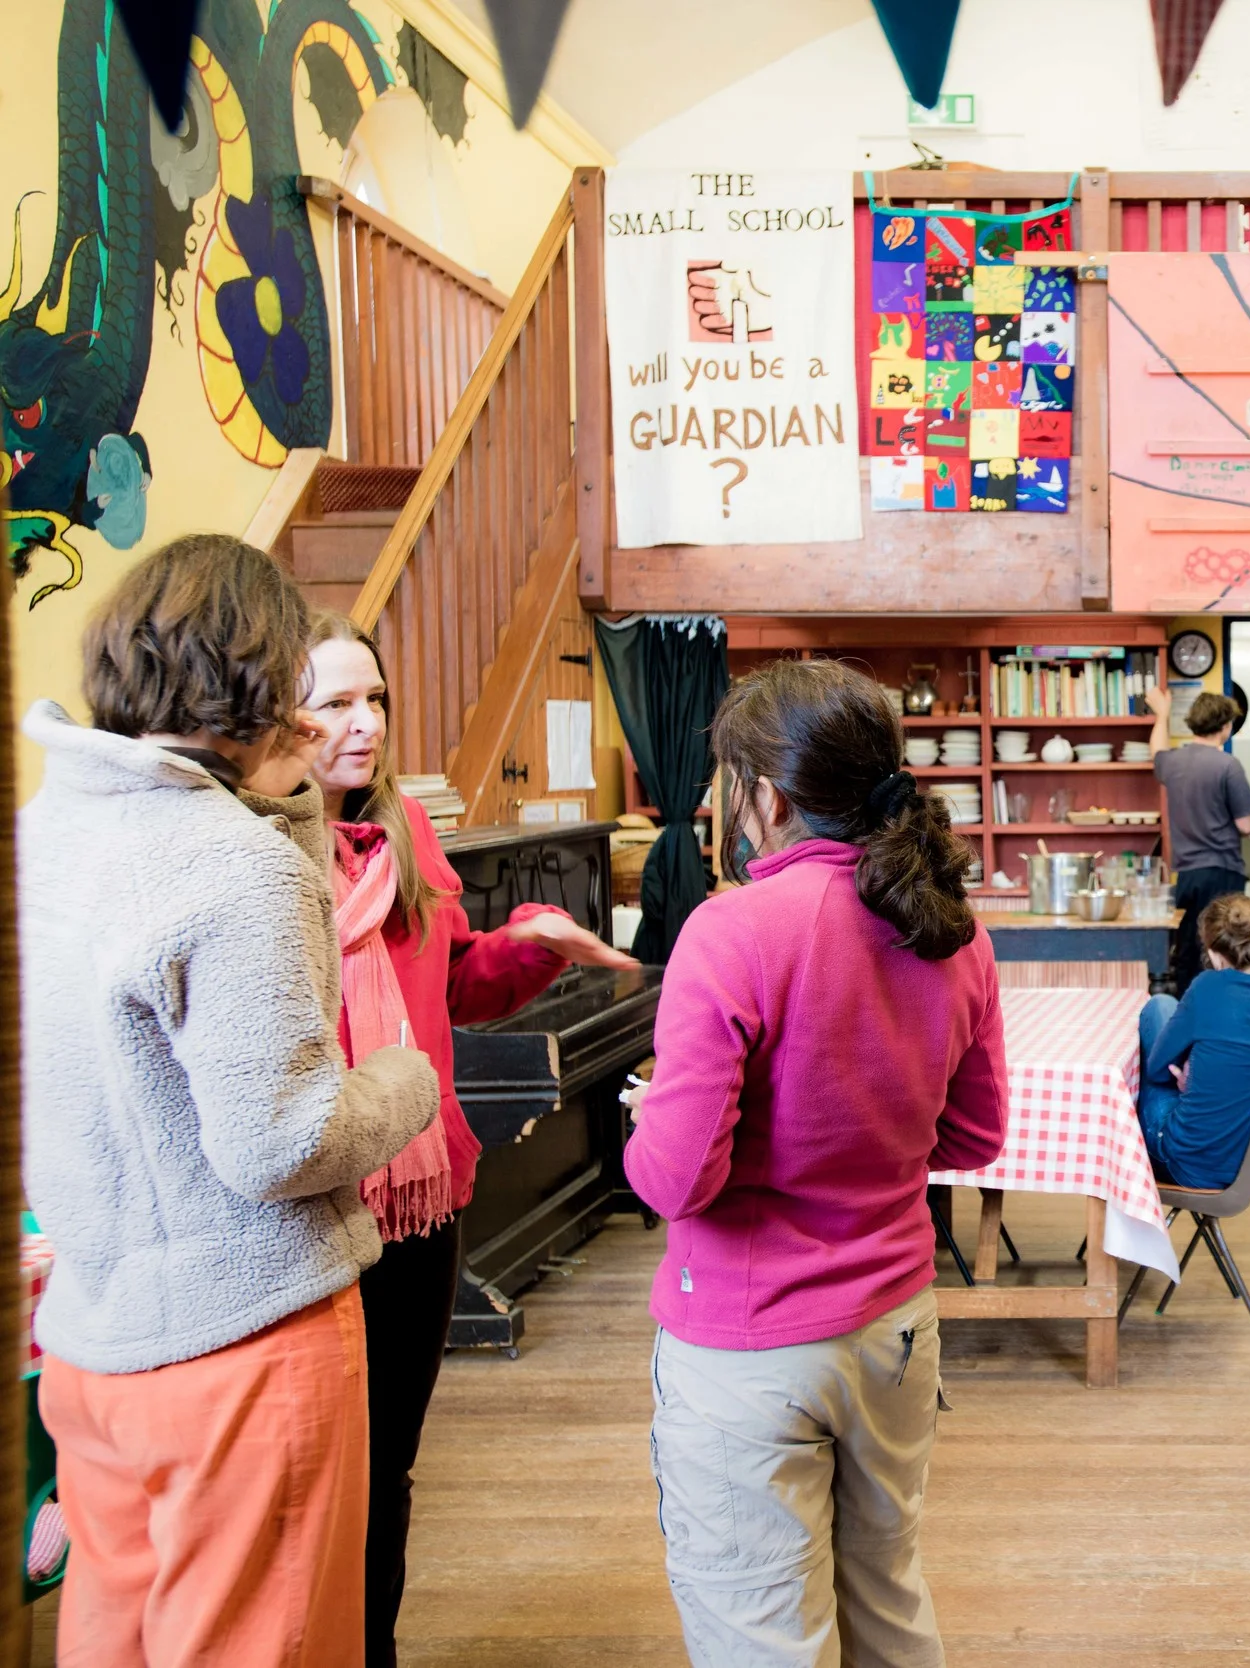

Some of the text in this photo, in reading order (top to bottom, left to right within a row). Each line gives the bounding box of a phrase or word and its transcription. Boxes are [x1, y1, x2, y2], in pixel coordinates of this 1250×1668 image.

[691, 173, 755, 197] THE
[609, 207, 844, 237] SMALL SCHOOL
[629, 350, 829, 391] will you be a
[630, 403, 845, 451] GUARDIAN
[709, 457, 748, 519] ?
